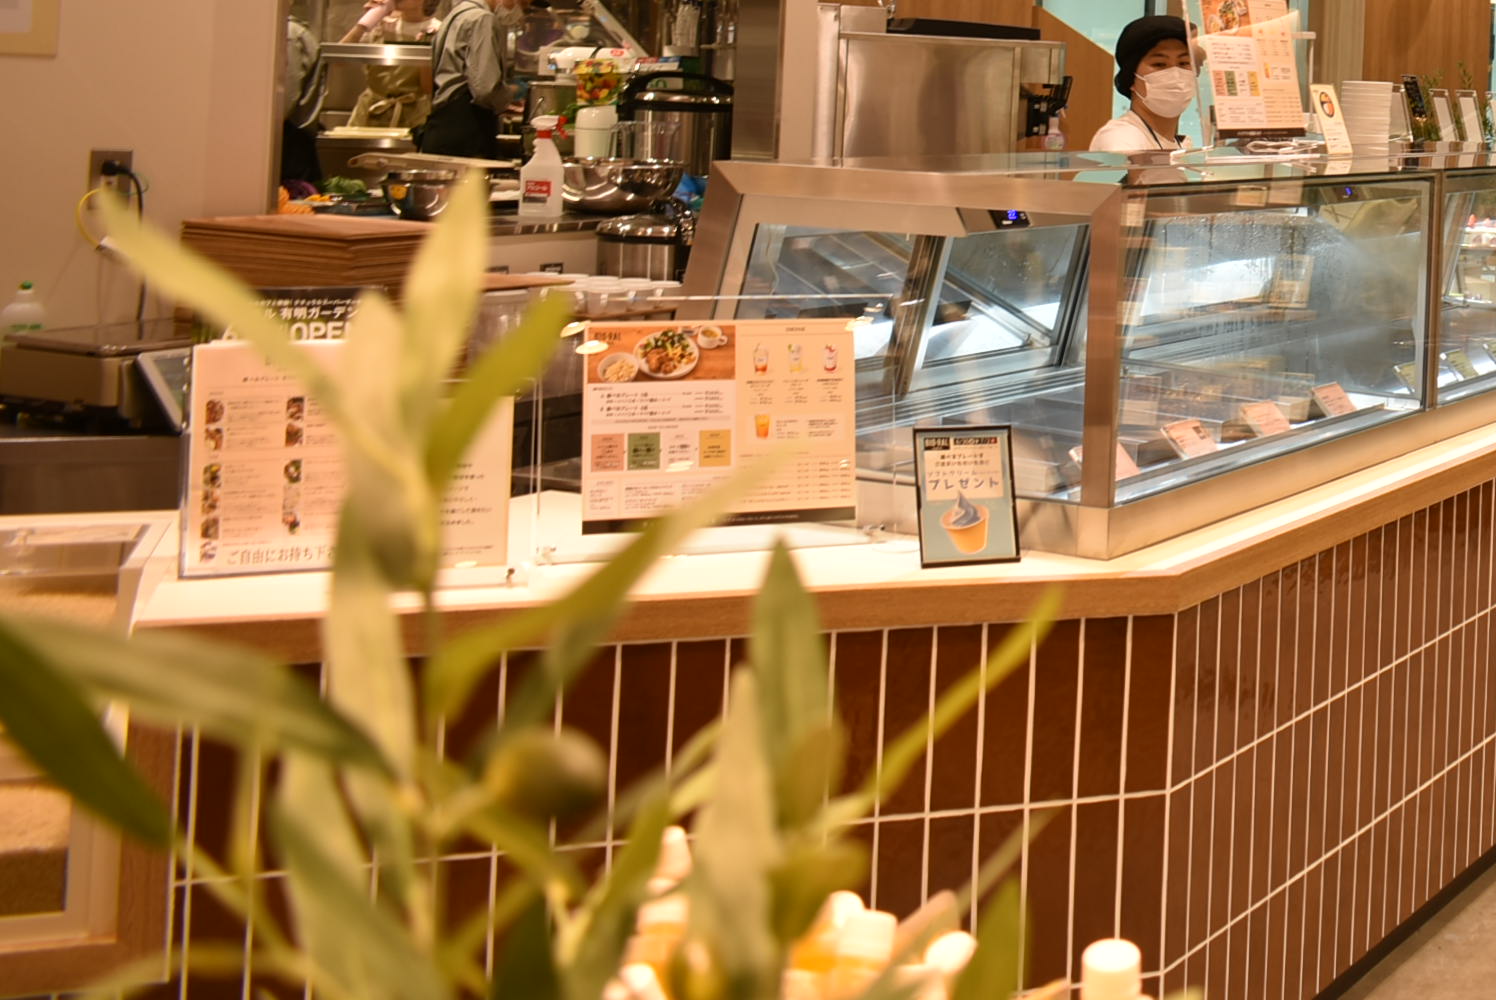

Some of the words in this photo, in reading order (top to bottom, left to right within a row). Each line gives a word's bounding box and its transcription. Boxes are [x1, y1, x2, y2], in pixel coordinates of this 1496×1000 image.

[928, 477, 1000, 490] プレゼント
[227, 545, 335, 565] ご自由にお持ち下さ
